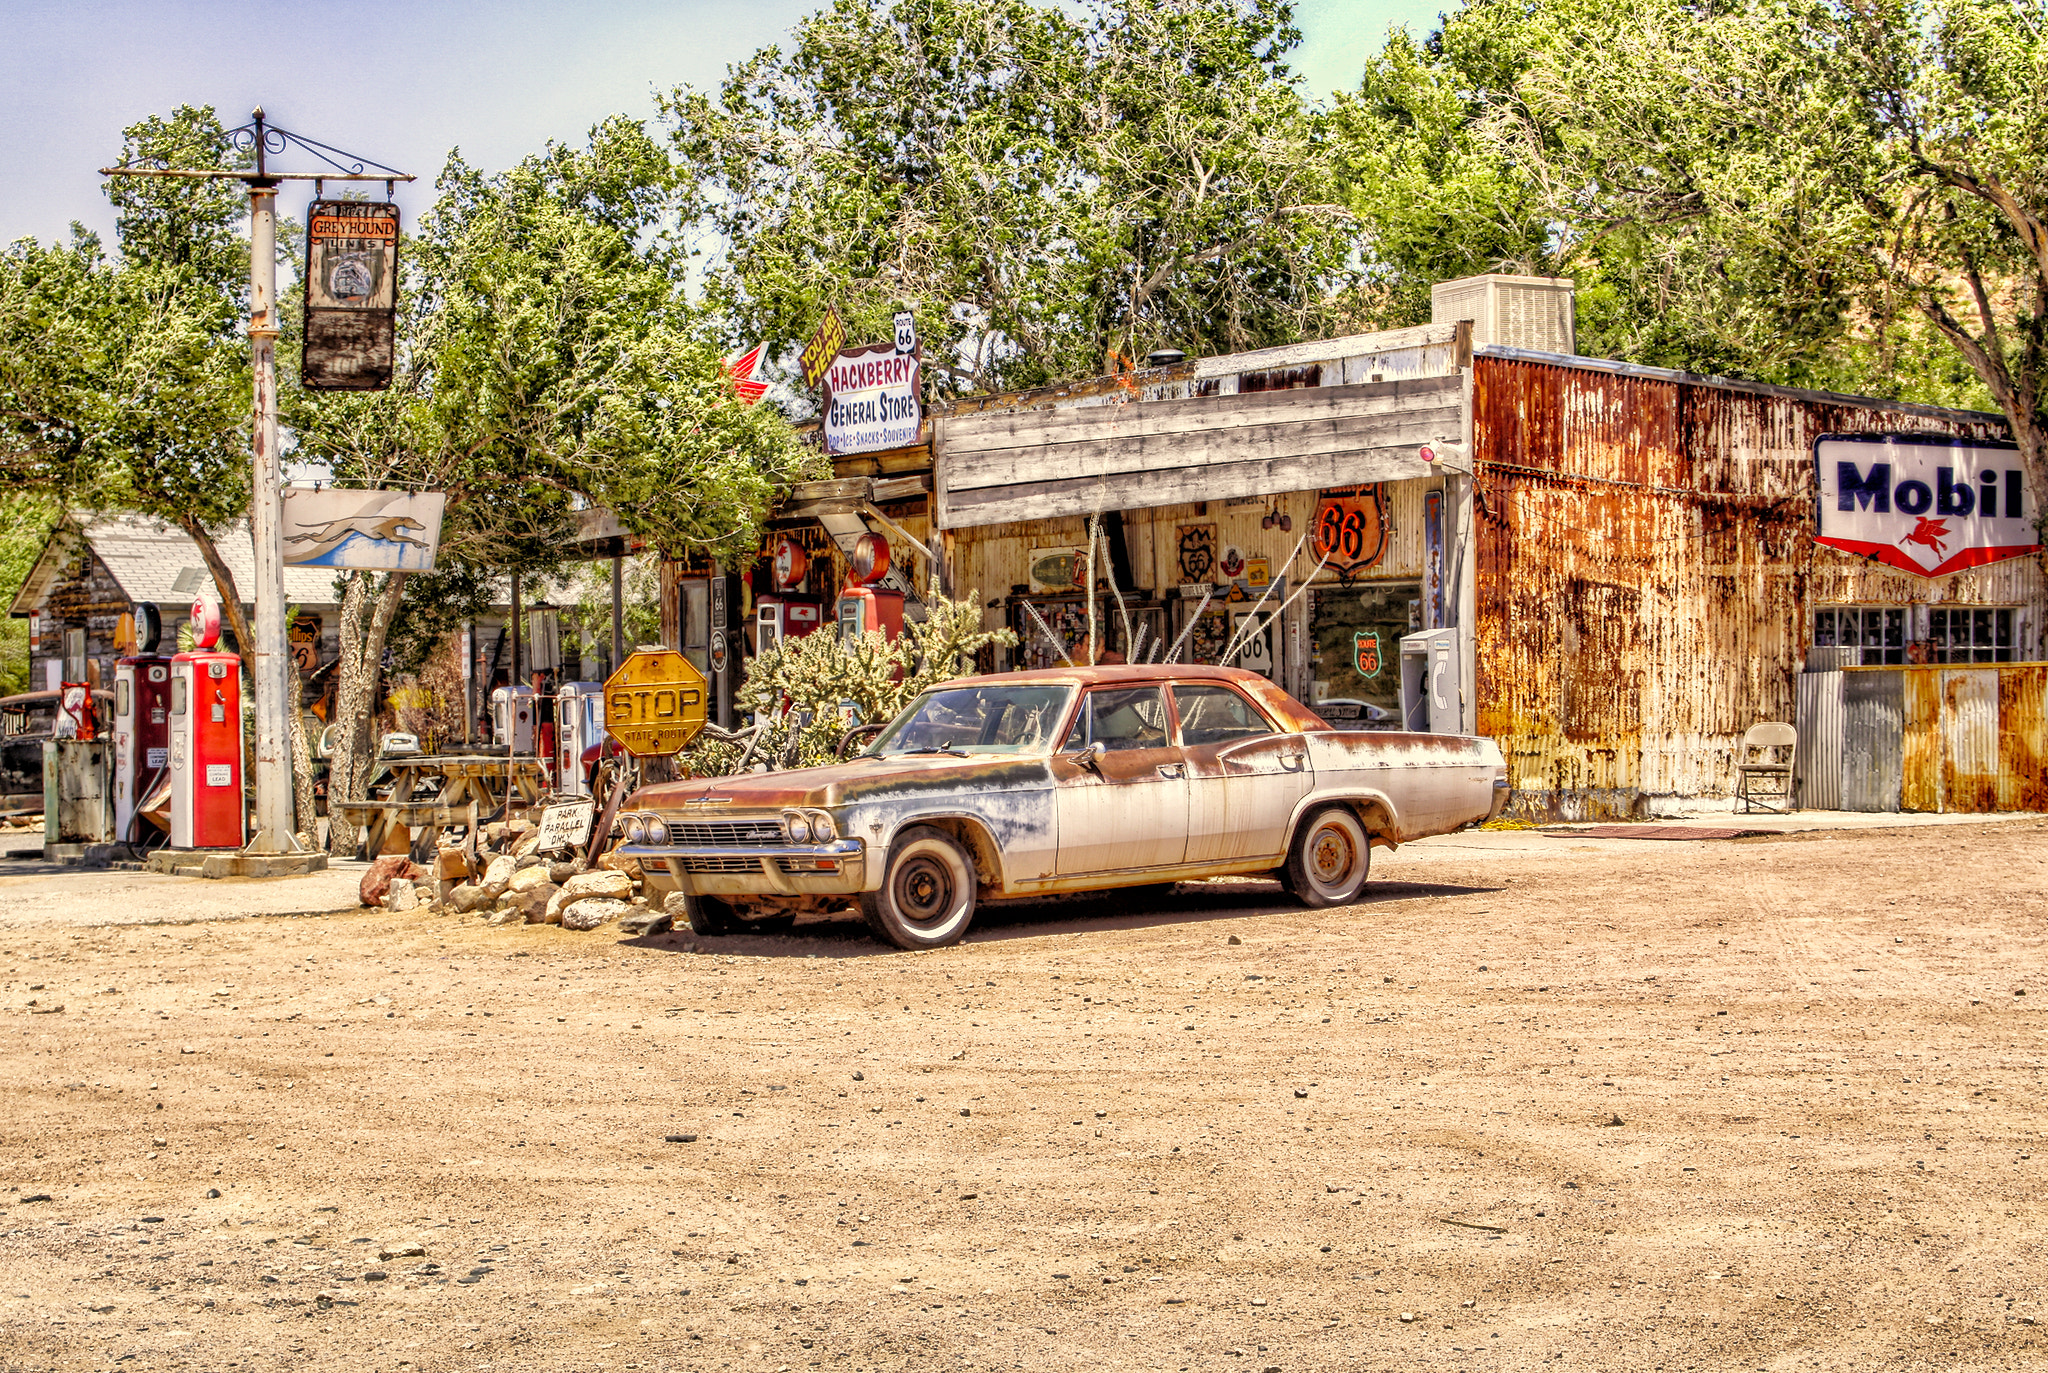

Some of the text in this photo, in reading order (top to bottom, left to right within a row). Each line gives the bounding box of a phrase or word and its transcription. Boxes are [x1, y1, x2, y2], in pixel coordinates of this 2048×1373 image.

[313, 220, 394, 235] GREYHOUND
[331, 239, 377, 248] LINS
[895, 317, 912, 327] ROUTE
[801, 309, 837, 368] YOU ARE
[898, 328, 912, 346] 66
[807, 321, 844, 388] HERE!
[830, 353, 911, 393] HACKBERRY
[830, 391, 914, 428] GENERAL STORE
[842, 431, 853, 448] ICE
[855, 428, 880, 447] SNACKS
[882, 426, 917, 444] SOUVENIRS
[1836, 460, 2023, 519] Mobil
[1318, 504, 1366, 560] 66
[1188, 553, 1205, 573] 66
[714, 597, 724, 611] 66
[1242, 629, 1263, 659] 66
[1357, 638, 1377, 650] ROUTE
[1359, 651, 1378, 672] 66
[610, 687, 701, 720] STOP
[623, 727, 689, 742] STATE ROUTE
[556, 808, 578, 820] PARK
[543, 819, 585, 834] PARALLEL
[550, 832, 573, 846] ONLY
